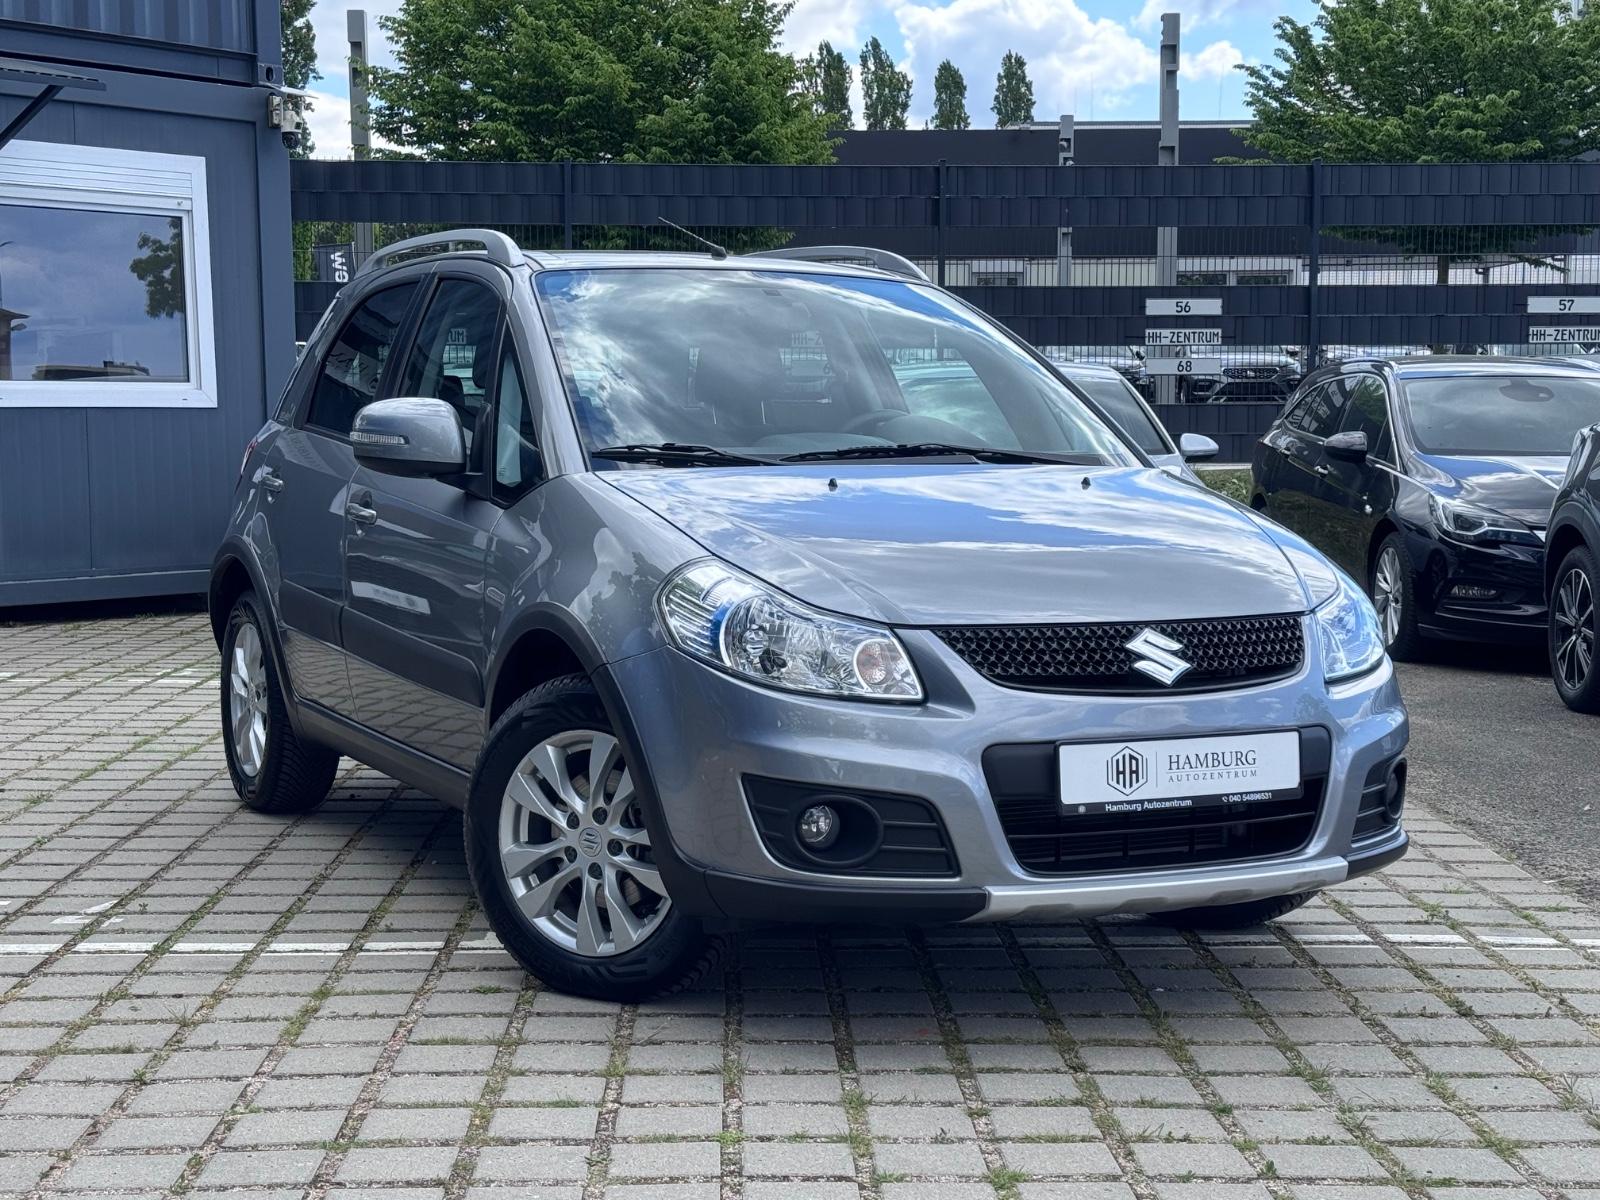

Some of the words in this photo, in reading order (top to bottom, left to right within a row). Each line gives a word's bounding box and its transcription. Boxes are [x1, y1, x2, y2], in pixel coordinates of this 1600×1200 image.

[1175, 301, 1191, 313] 56
[1559, 299, 1575, 311] 57
[1147, 331, 1219, 343] HH-ZENTRUM
[1531, 329, 1600, 341] HH-ZENTRU
[1177, 360, 1192, 372] 68
[1168, 750, 1256, 770] HAMBURG
[1116, 753, 1139, 789] HA
[1168, 770, 1257, 782] AUTOZENTRUM
[1229, 794, 1241, 802] 040
[1105, 803, 1141, 811] Hamburg
[1143, 799, 1192, 809] Autozentrum
